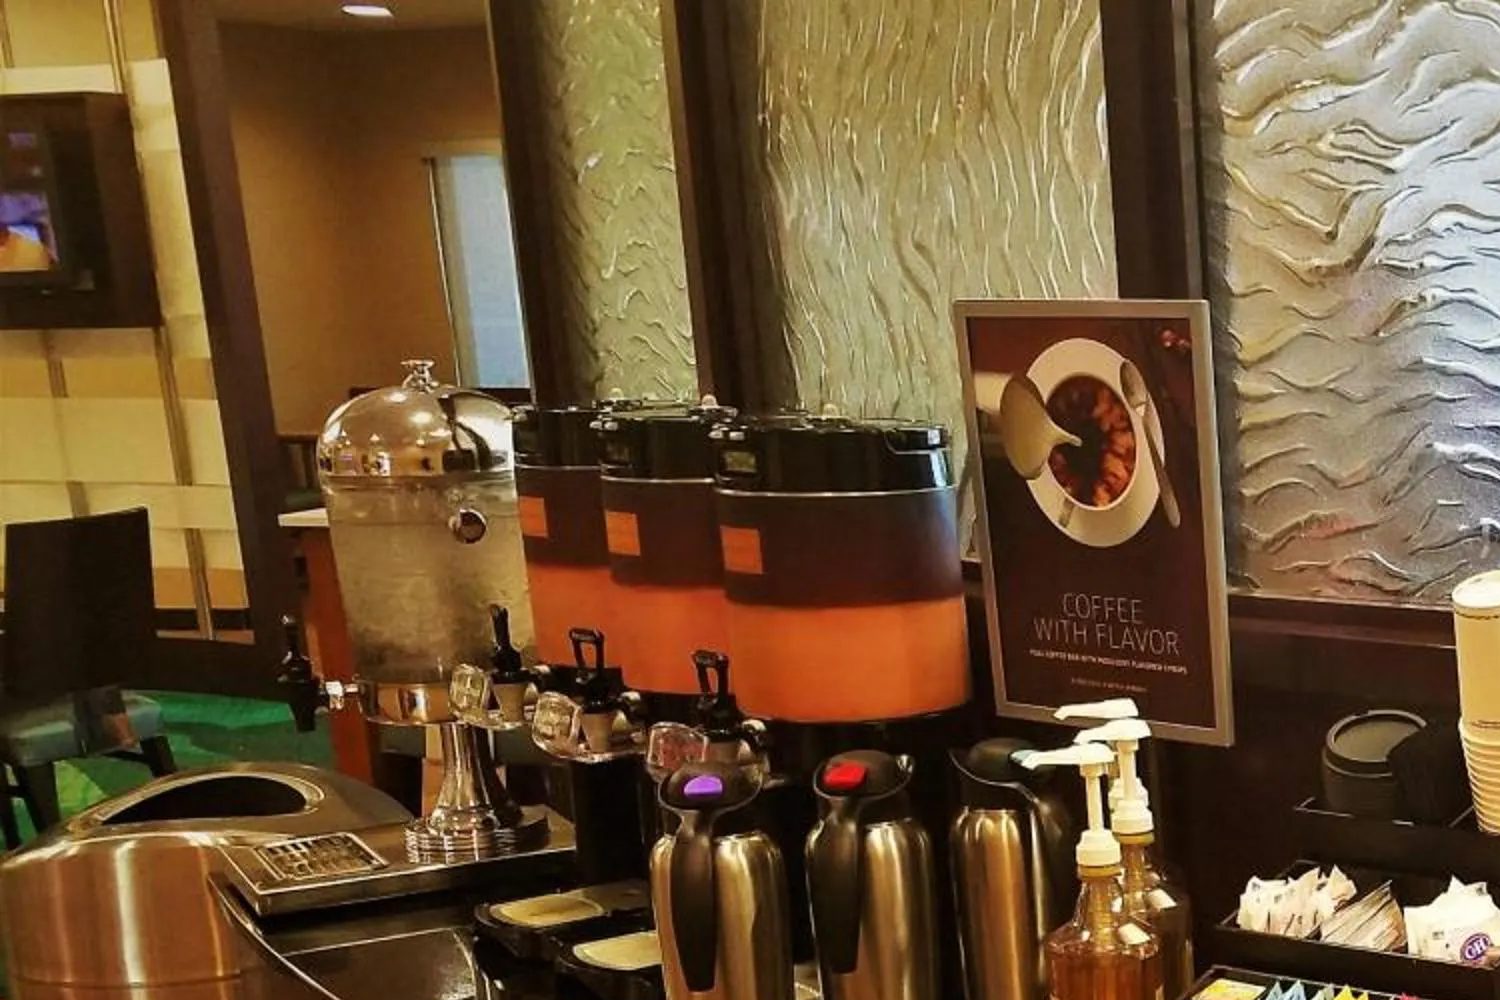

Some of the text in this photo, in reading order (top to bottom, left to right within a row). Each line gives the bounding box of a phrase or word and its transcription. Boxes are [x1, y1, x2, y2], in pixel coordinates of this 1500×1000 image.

[1062, 592, 1143, 625] COFFEE
[1033, 616, 1181, 657] WITH FLAVOR
